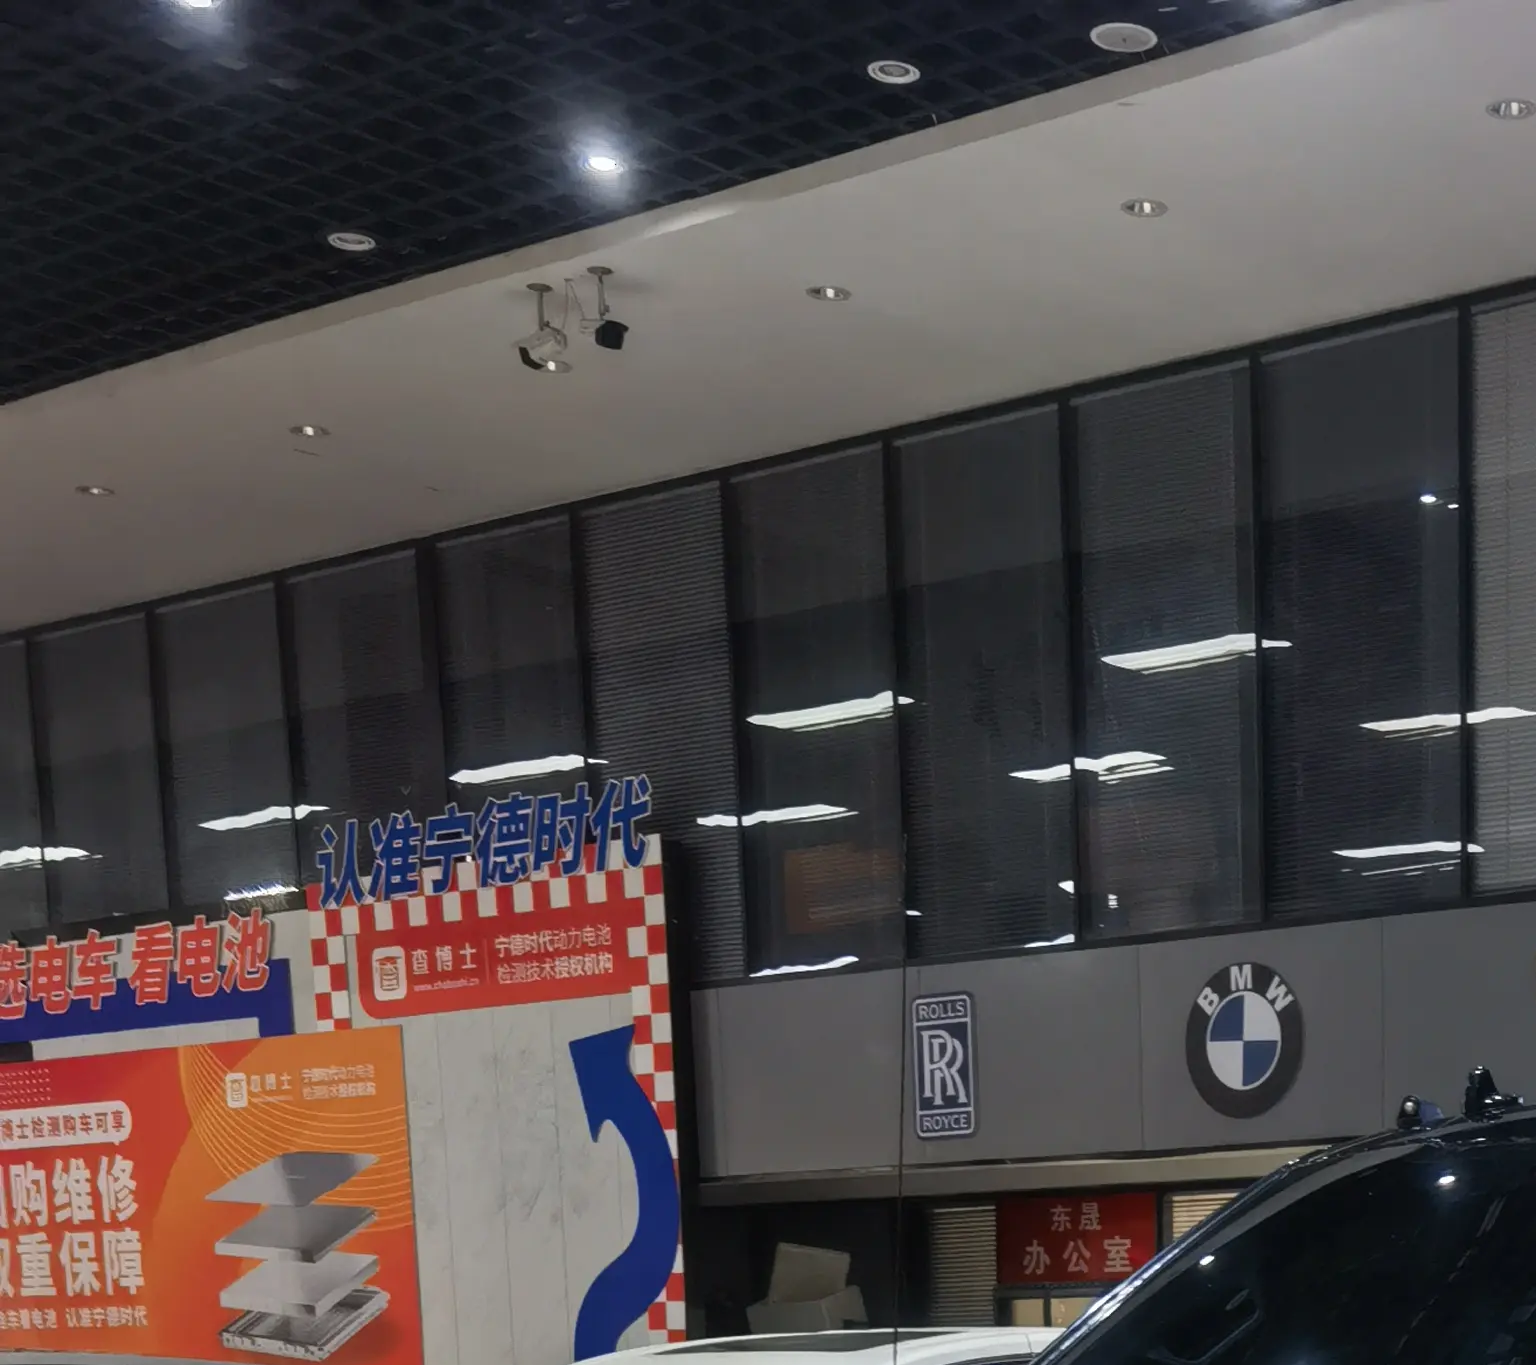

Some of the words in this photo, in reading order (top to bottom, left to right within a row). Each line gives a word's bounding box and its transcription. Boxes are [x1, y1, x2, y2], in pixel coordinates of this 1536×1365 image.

[316, 774, 652, 909] 认准宁德时代
[128, 907, 270, 1006] 看电池
[411, 942, 477, 976] 查博士
[494, 924, 612, 958] 宁德时代动力电池
[1196, 963, 1296, 1017] BMW
[918, 1001, 965, 1020] ROLLS
[922, 1114, 969, 1132] ROYCE
[0, 1153, 139, 1229] 购维修
[1051, 1202, 1103, 1232] 东晟
[1022, 1235, 1133, 1276] 办公室
